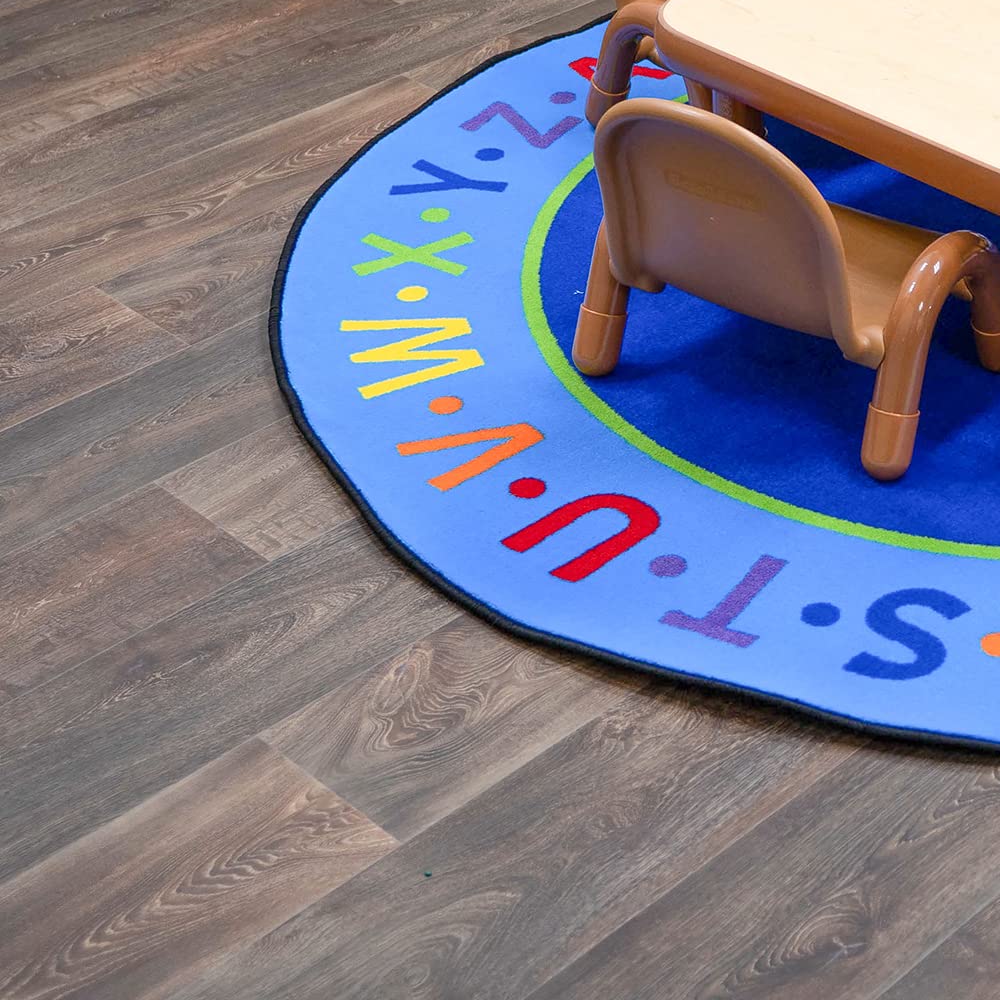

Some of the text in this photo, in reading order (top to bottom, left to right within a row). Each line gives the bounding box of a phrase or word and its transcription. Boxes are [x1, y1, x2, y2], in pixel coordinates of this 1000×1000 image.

[458, 101, 584, 149] Z
[389, 159, 509, 195] Y
[352, 231, 476, 277] X
[340, 317, 486, 400] W
[396, 422, 545, 492] V
[501, 492, 661, 582] U
[658, 553, 789, 648] T
[841, 586, 973, 681] S
